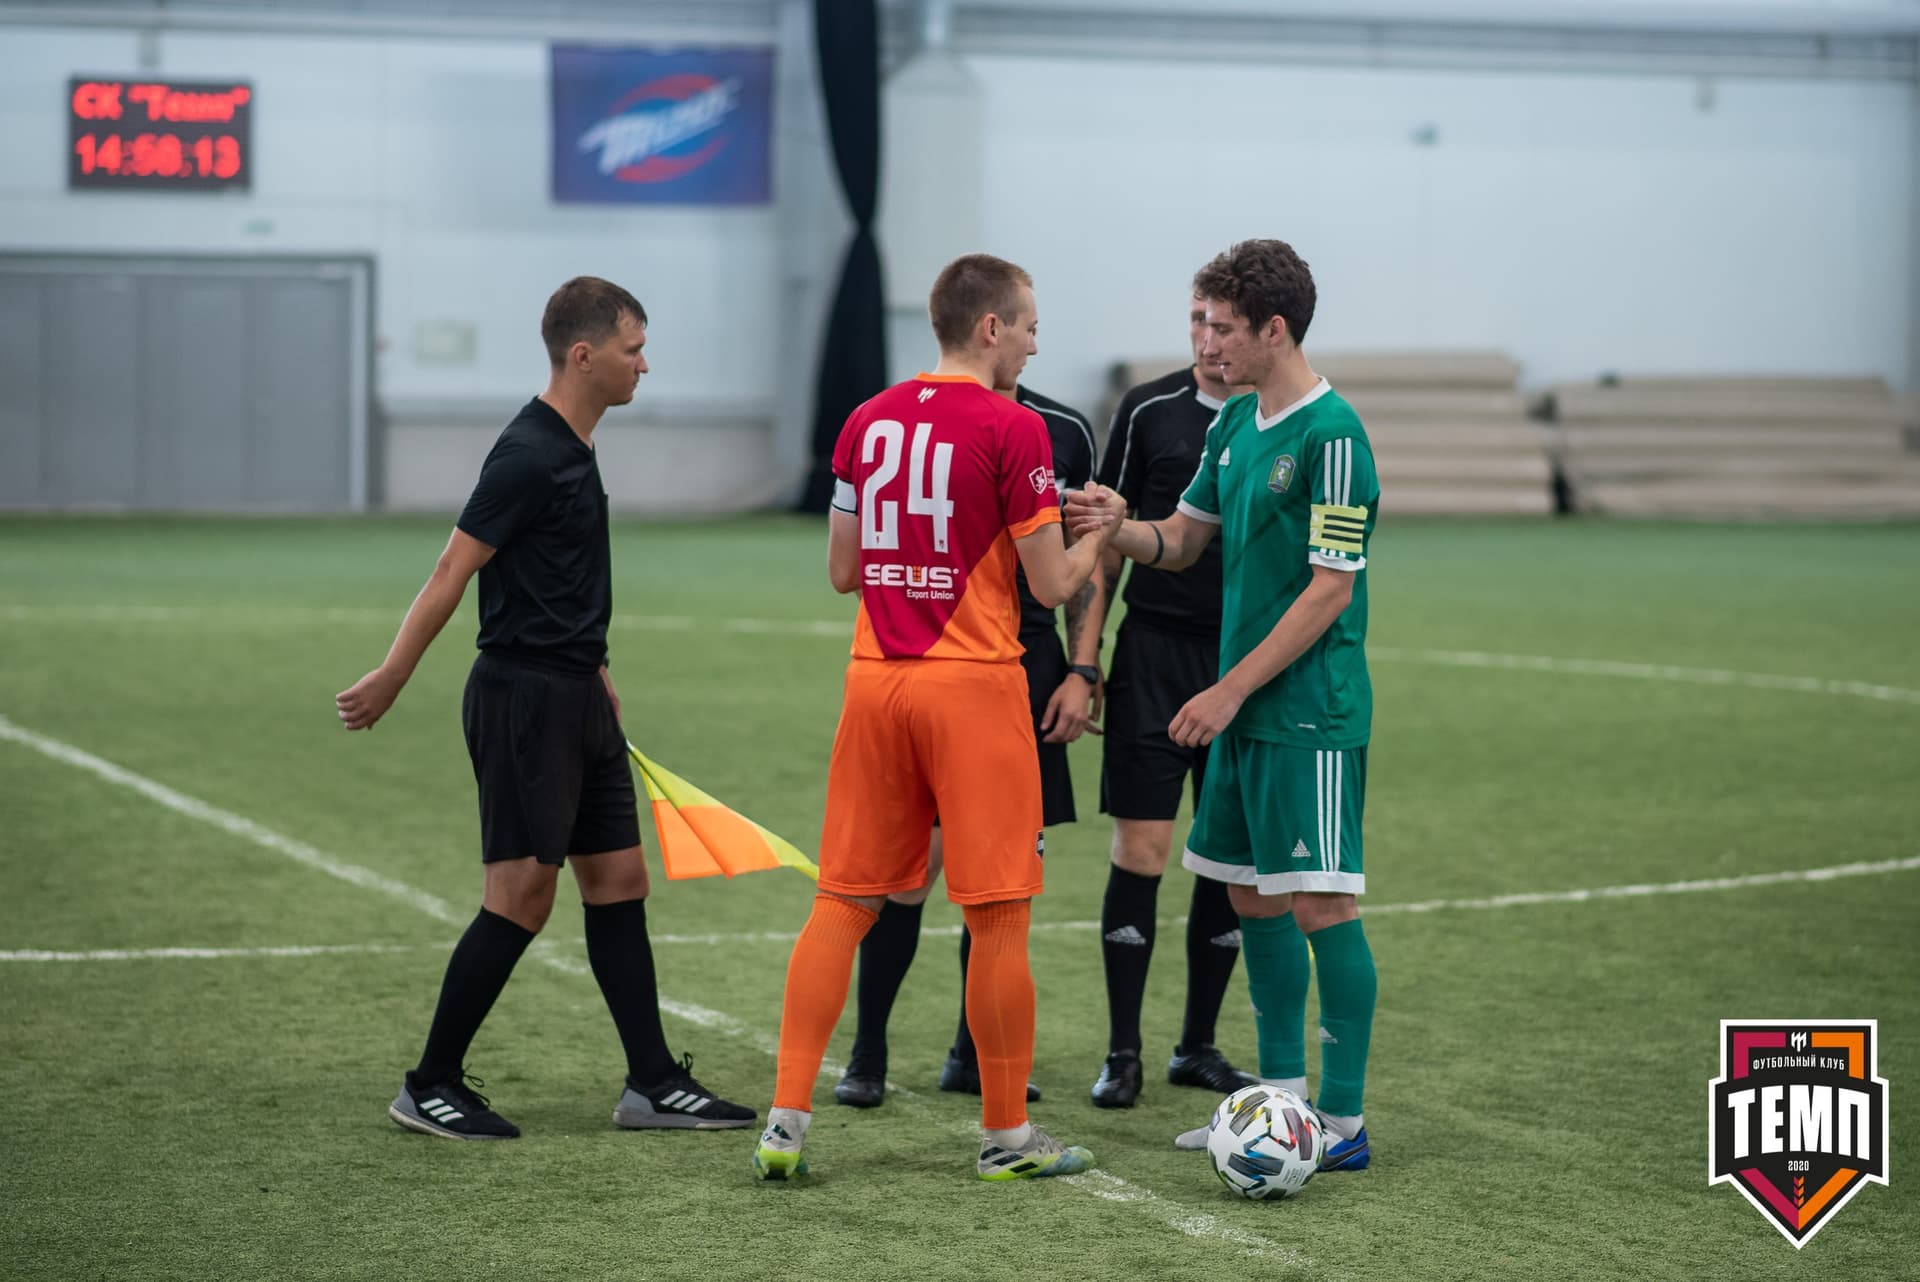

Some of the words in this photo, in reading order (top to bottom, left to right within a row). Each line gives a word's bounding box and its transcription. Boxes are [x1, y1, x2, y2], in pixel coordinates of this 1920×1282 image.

[861, 419, 954, 554] 24
[864, 563, 953, 589] SEUS
[930, 590, 955, 600] Union
